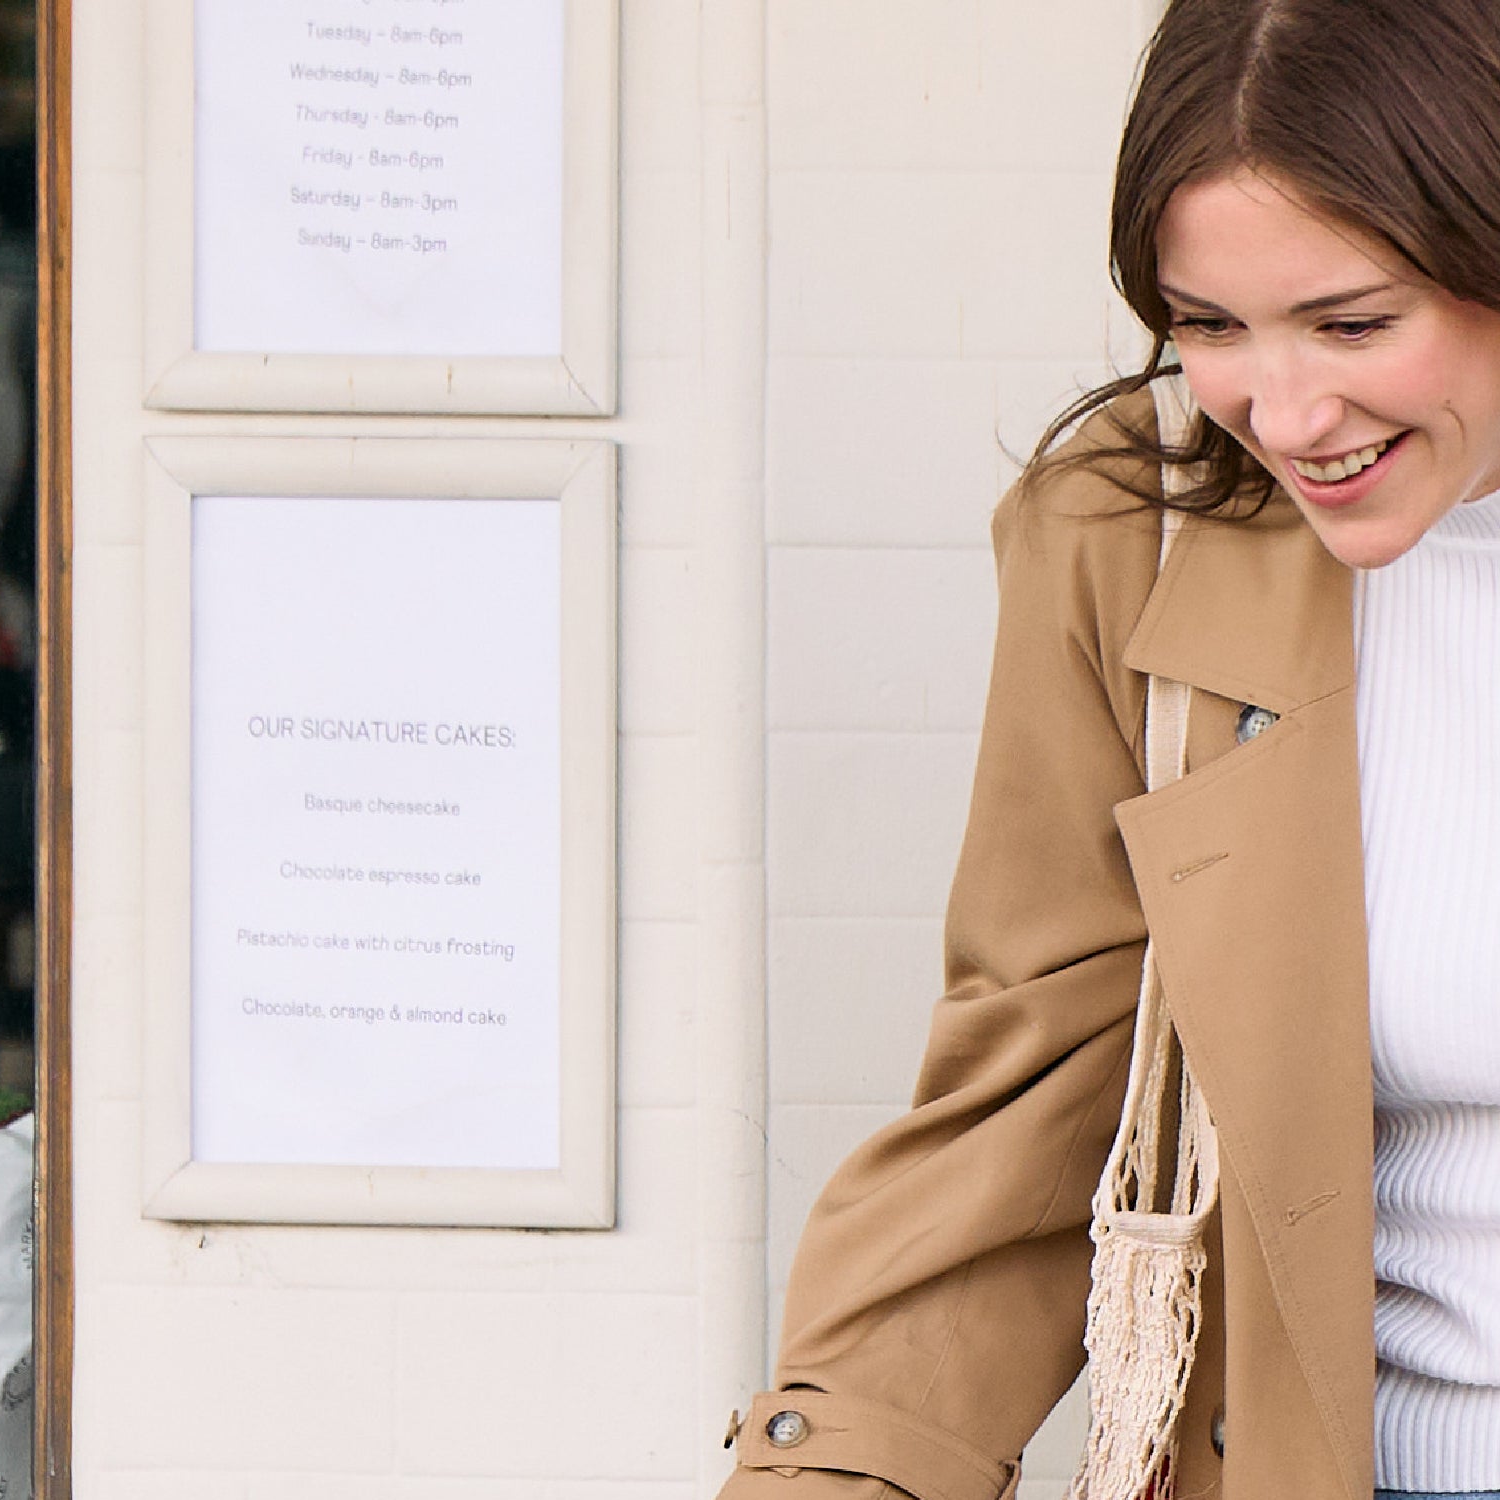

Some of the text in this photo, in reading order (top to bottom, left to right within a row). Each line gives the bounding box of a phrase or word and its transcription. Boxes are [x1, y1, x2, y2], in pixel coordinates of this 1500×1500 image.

[307, 22, 371, 47] Tuesday
[390, 25, 463, 47] 8am-6pm
[290, 63, 379, 88] Wednesday
[399, 67, 472, 89] 8am-6pm
[296, 104, 368, 129] Thursday
[384, 107, 459, 131] 8am-6pm
[302, 145, 352, 169] Friday
[368, 148, 444, 171] 8am-6pm
[291, 187, 360, 212] Saturday
[380, 191, 457, 214] 8am-3pm
[298, 227, 351, 252] Sunday
[370, 231, 447, 254] 8am-3pm
[248, 716, 516, 748] OUR SIGNATURE CAKES:
[304, 793, 460, 817] Basque cheesecake
[279, 860, 481, 887] Chocolate espresso cake
[237, 928, 515, 962] Pistachio cake with citrus frosting
[241, 998, 507, 1026] Chocolate, orange & almond cake
